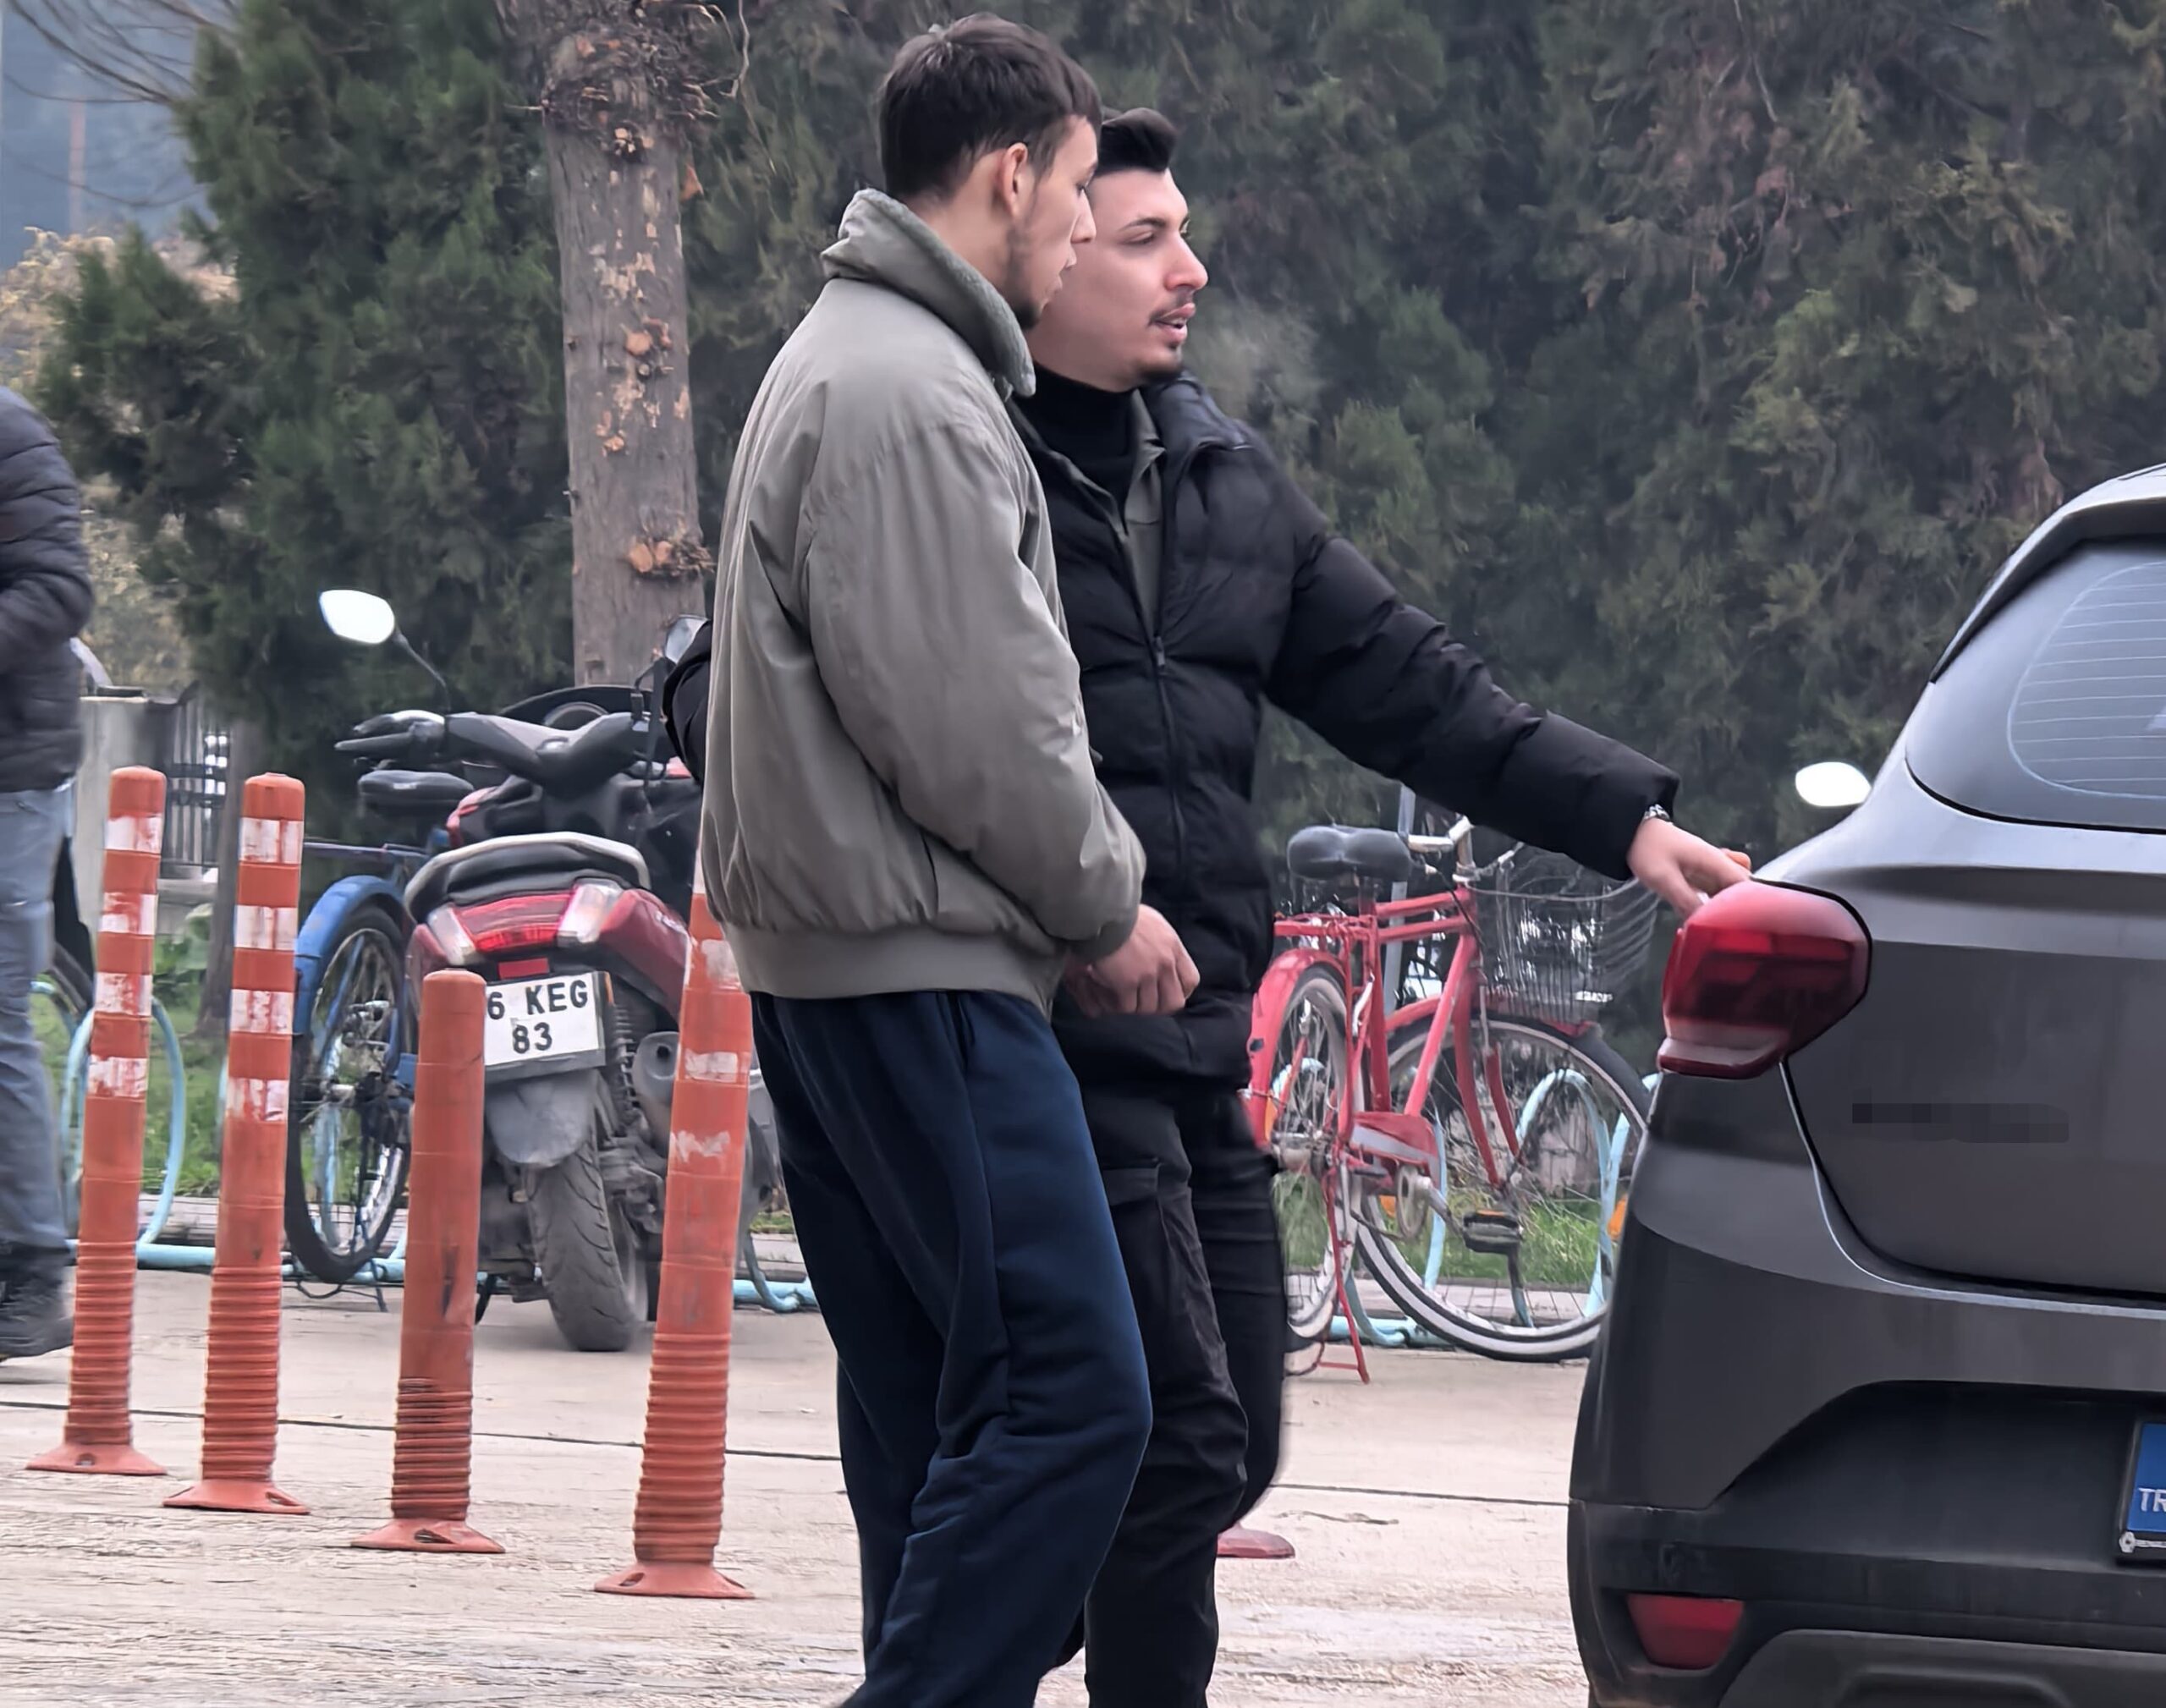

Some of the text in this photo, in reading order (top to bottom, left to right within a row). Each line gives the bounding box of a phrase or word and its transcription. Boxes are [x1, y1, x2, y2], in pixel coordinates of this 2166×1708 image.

[487, 980, 588, 1020] 6 KEG
[512, 1022, 552, 1054] 83
